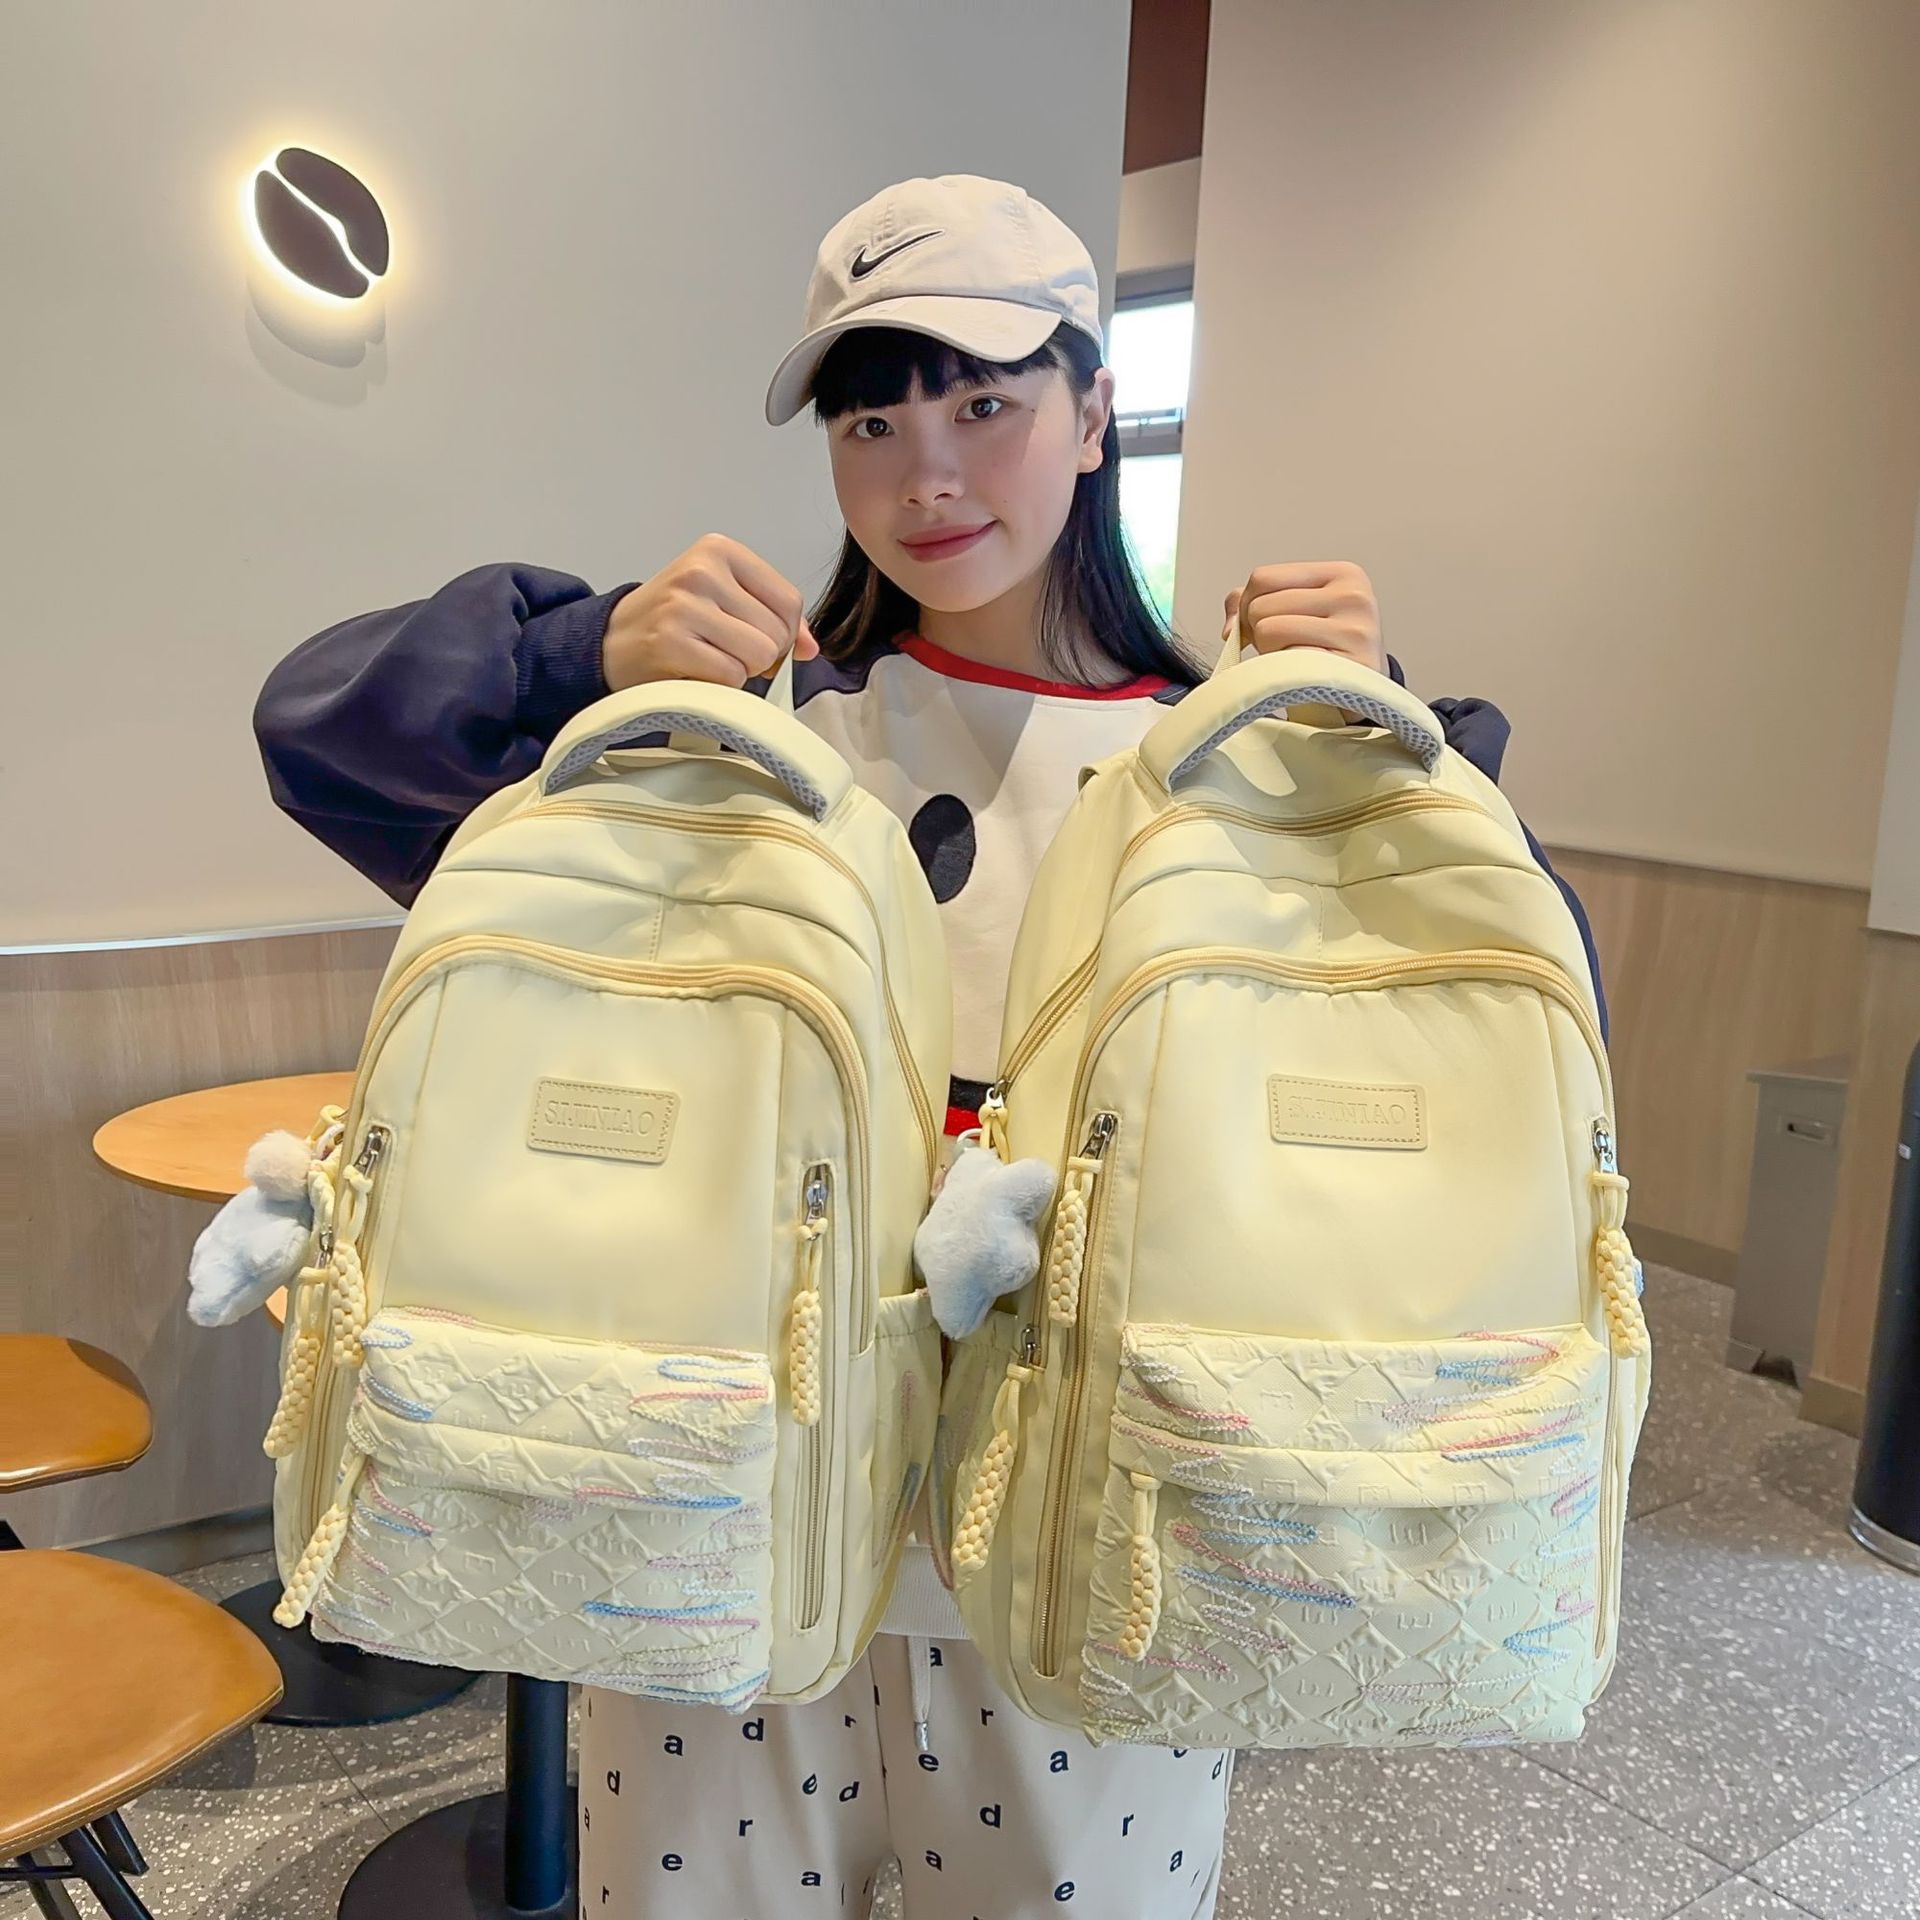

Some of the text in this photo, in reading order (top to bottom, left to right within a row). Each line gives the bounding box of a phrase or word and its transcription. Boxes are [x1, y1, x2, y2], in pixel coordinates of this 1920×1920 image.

[741, 1717, 765, 1742] d
[663, 1734, 684, 1757] a
[918, 1753, 940, 1772] e
[1049, 1750, 1069, 1774] a
[979, 1803, 1001, 1829] d
[1121, 1813, 1135, 1838] r
[738, 1819, 754, 1837] r
[661, 1853, 684, 1872] e
[800, 1870, 822, 1887] a
[1053, 1881, 1076, 1903] e
